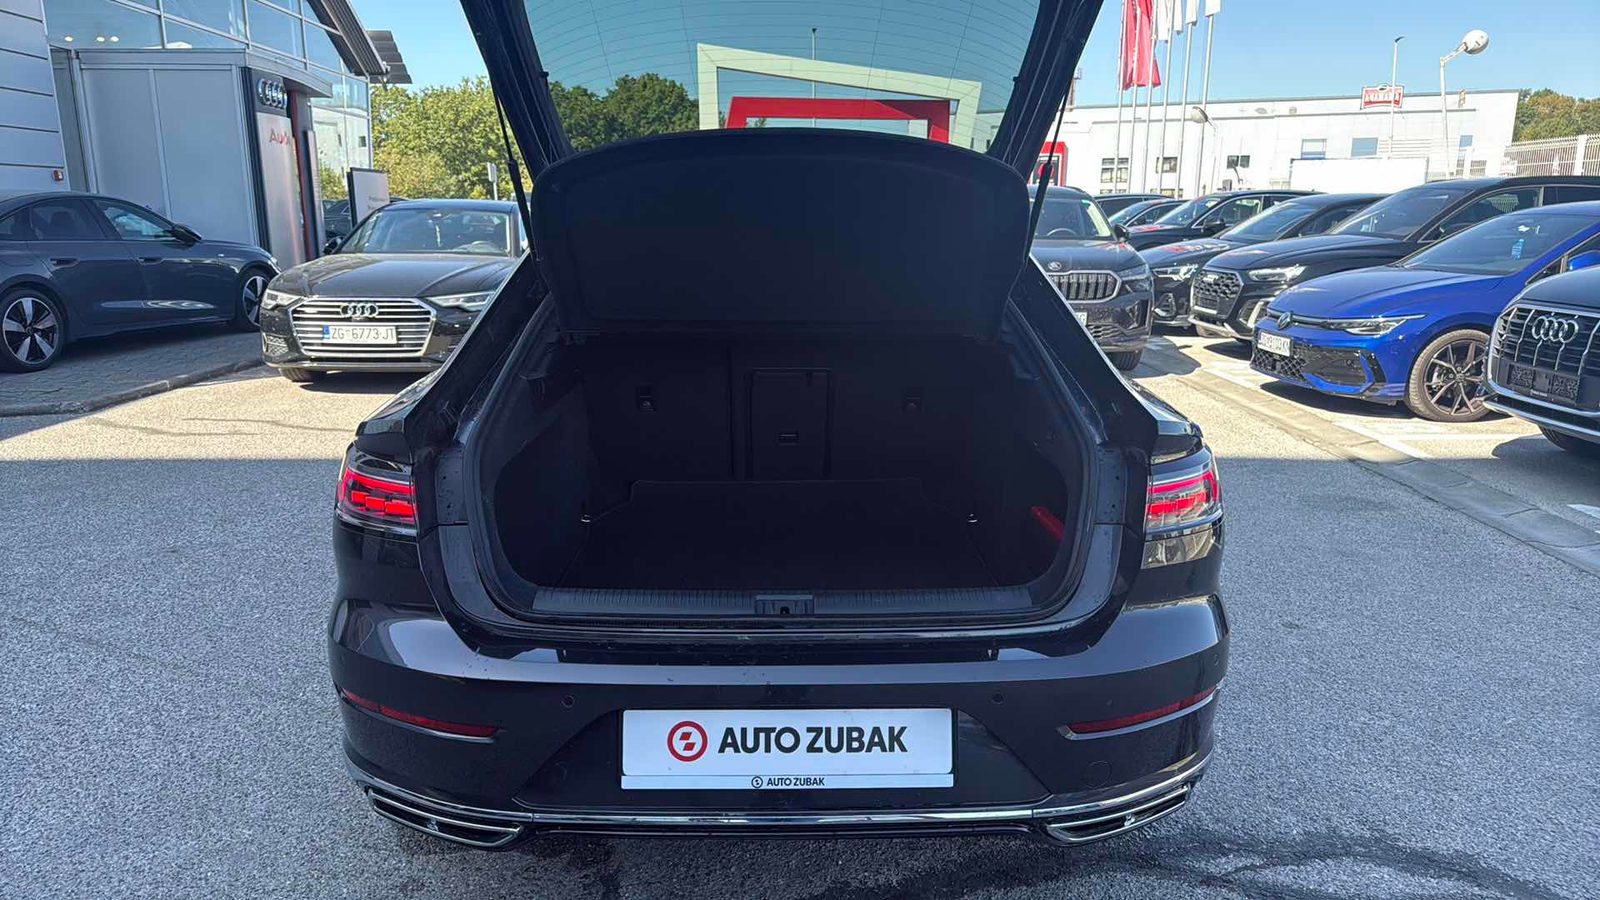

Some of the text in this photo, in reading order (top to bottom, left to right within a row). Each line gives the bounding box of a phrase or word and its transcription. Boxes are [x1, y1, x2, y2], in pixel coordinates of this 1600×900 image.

[718, 726, 908, 754] AUTO ZUBAK
[766, 777, 825, 788] AUTO ZUBAK
